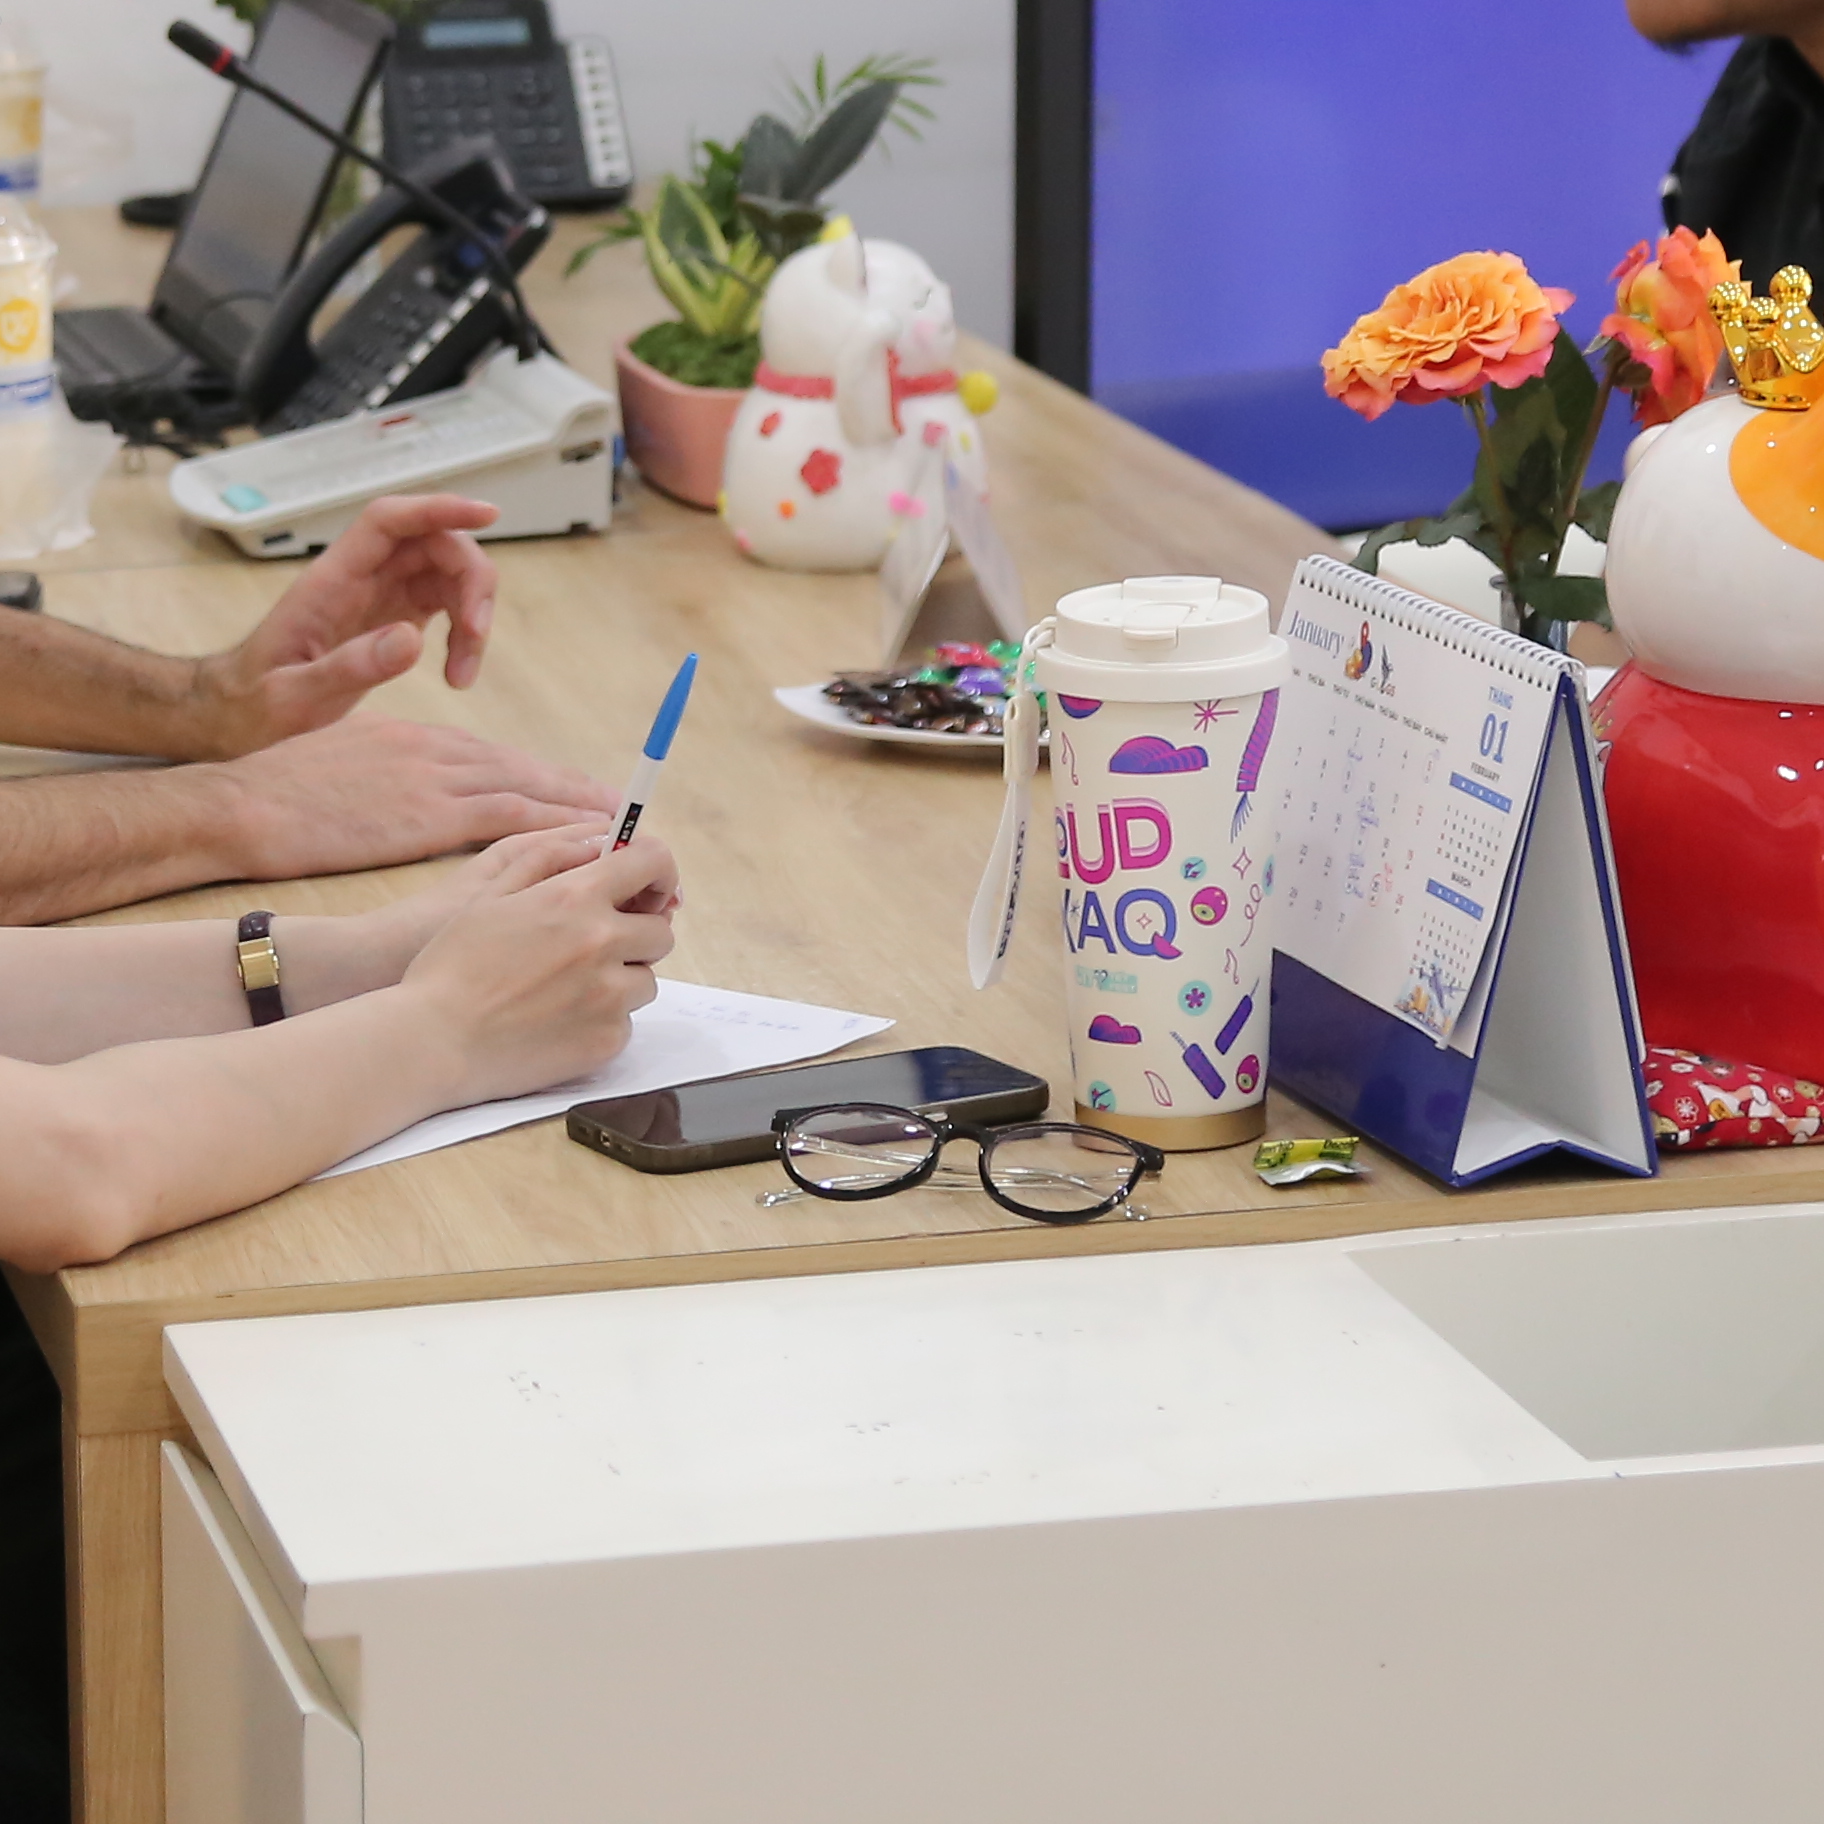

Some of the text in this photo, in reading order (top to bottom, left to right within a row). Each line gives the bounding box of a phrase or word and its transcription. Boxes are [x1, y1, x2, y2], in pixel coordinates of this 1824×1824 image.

[1287, 610, 1346, 660] January
[1480, 712, 1510, 764] 01
[1470, 761, 1501, 783] FEBRUARY
[1451, 871, 1472, 888] MARCH
